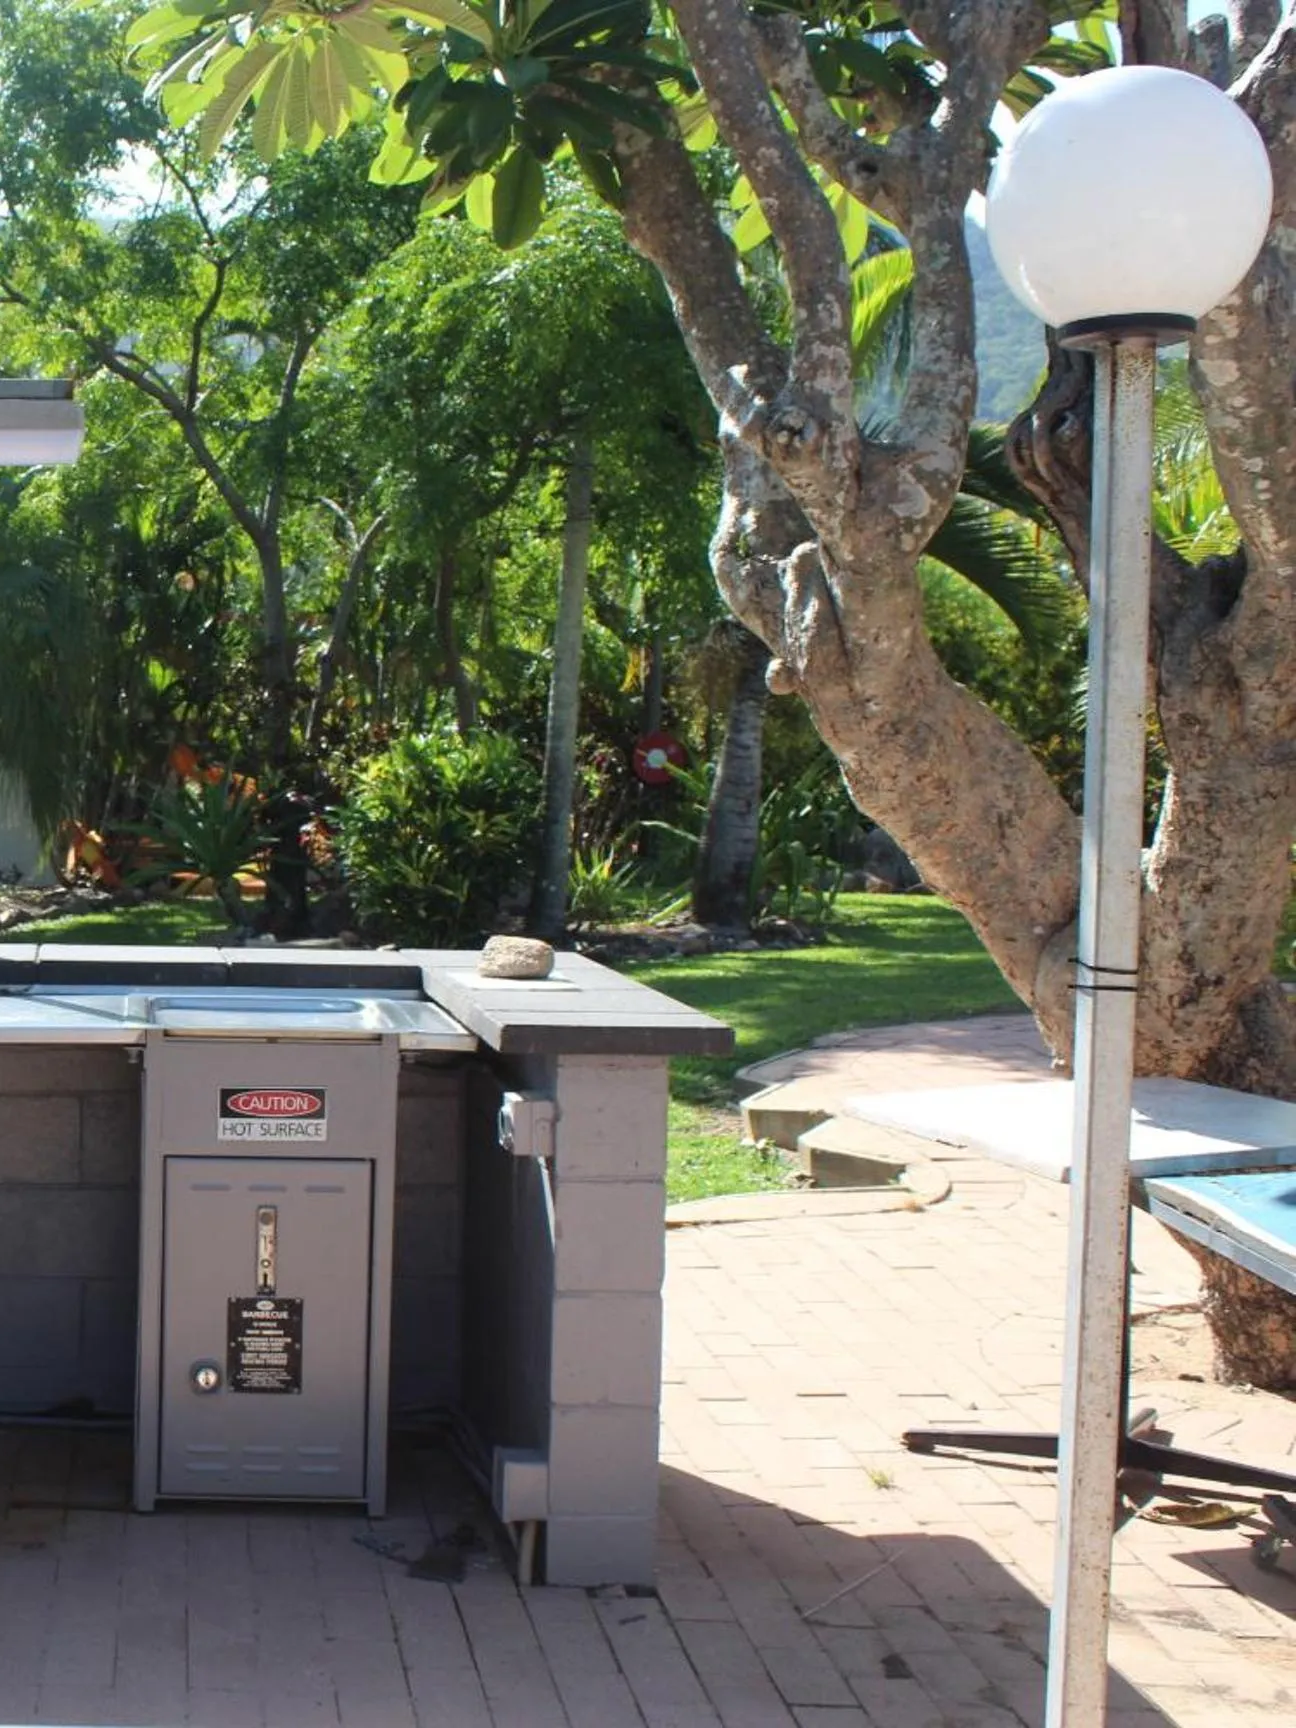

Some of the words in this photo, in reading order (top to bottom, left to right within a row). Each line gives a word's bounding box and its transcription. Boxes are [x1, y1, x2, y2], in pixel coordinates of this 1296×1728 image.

[239, 1097, 309, 1111] CAUTION
[222, 1123, 254, 1136] HOT
[260, 1123, 323, 1136] SURFACE
[241, 1311, 289, 1320] BARBECUE
